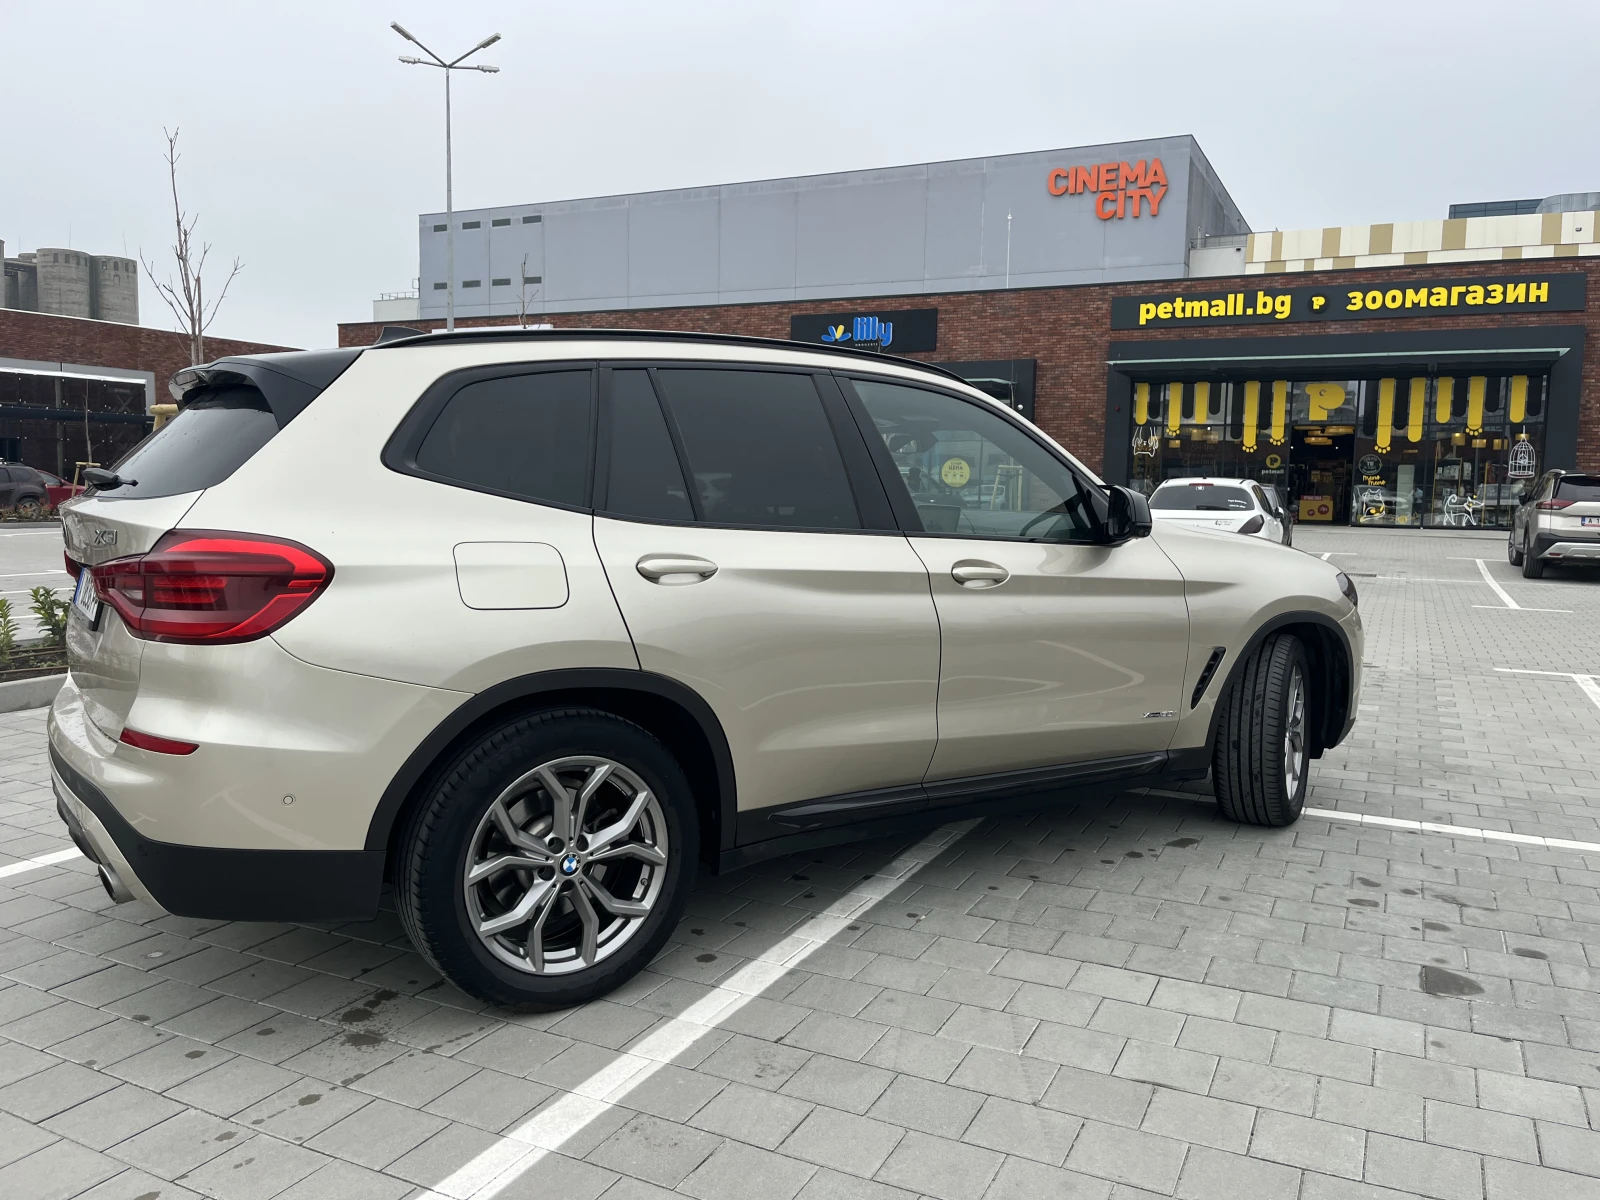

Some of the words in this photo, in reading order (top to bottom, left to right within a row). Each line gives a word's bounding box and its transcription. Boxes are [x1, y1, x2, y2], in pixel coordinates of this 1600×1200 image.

[1047, 157, 1169, 196] CINEMA
[1095, 185, 1169, 220] CITY
[1138, 290, 1292, 326] petmall.bg
[1346, 281, 1550, 312] зоомагазин
[853, 316, 893, 347] lilly
[94, 529, 118, 545] X3
